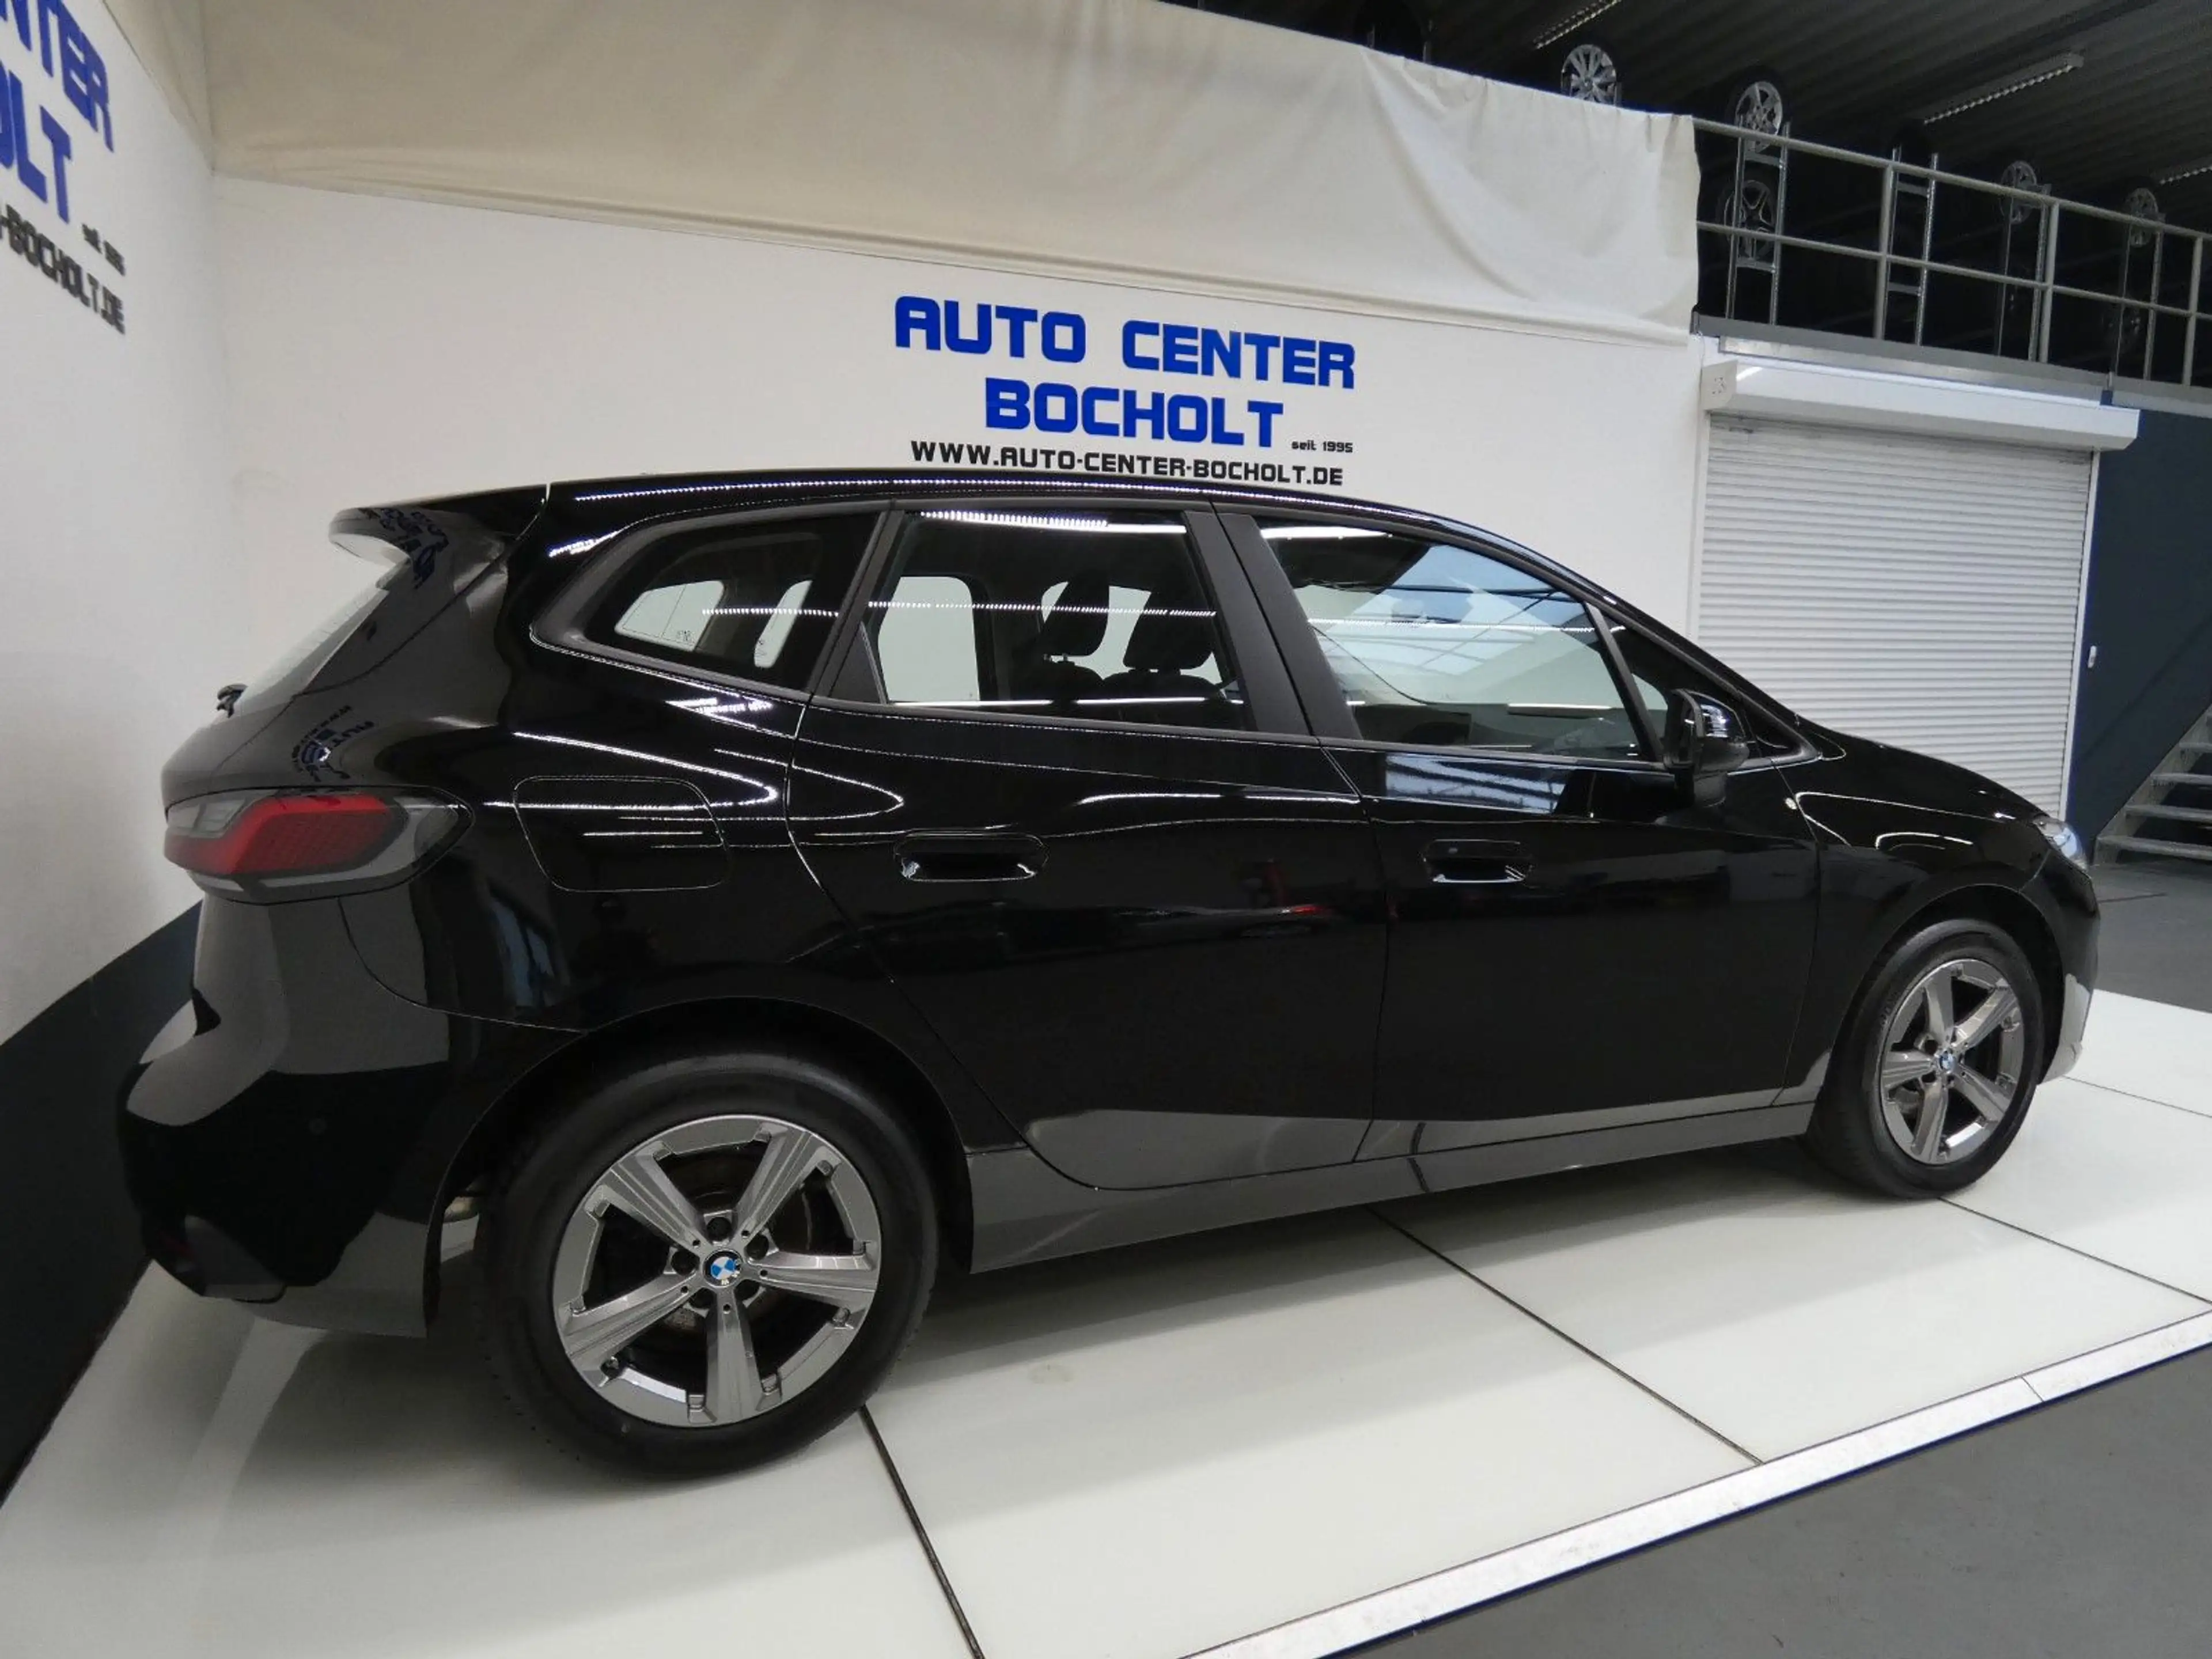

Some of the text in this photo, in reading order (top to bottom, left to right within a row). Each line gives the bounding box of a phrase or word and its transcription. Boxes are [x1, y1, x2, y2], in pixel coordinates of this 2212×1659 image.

[895, 295, 1355, 390] AUTO CENTER
[986, 377, 1353, 453] BOCHOLT seit 1995
[911, 440, 1343, 486] WWW.AUTO-CENTER-BOCHOLT.DE
